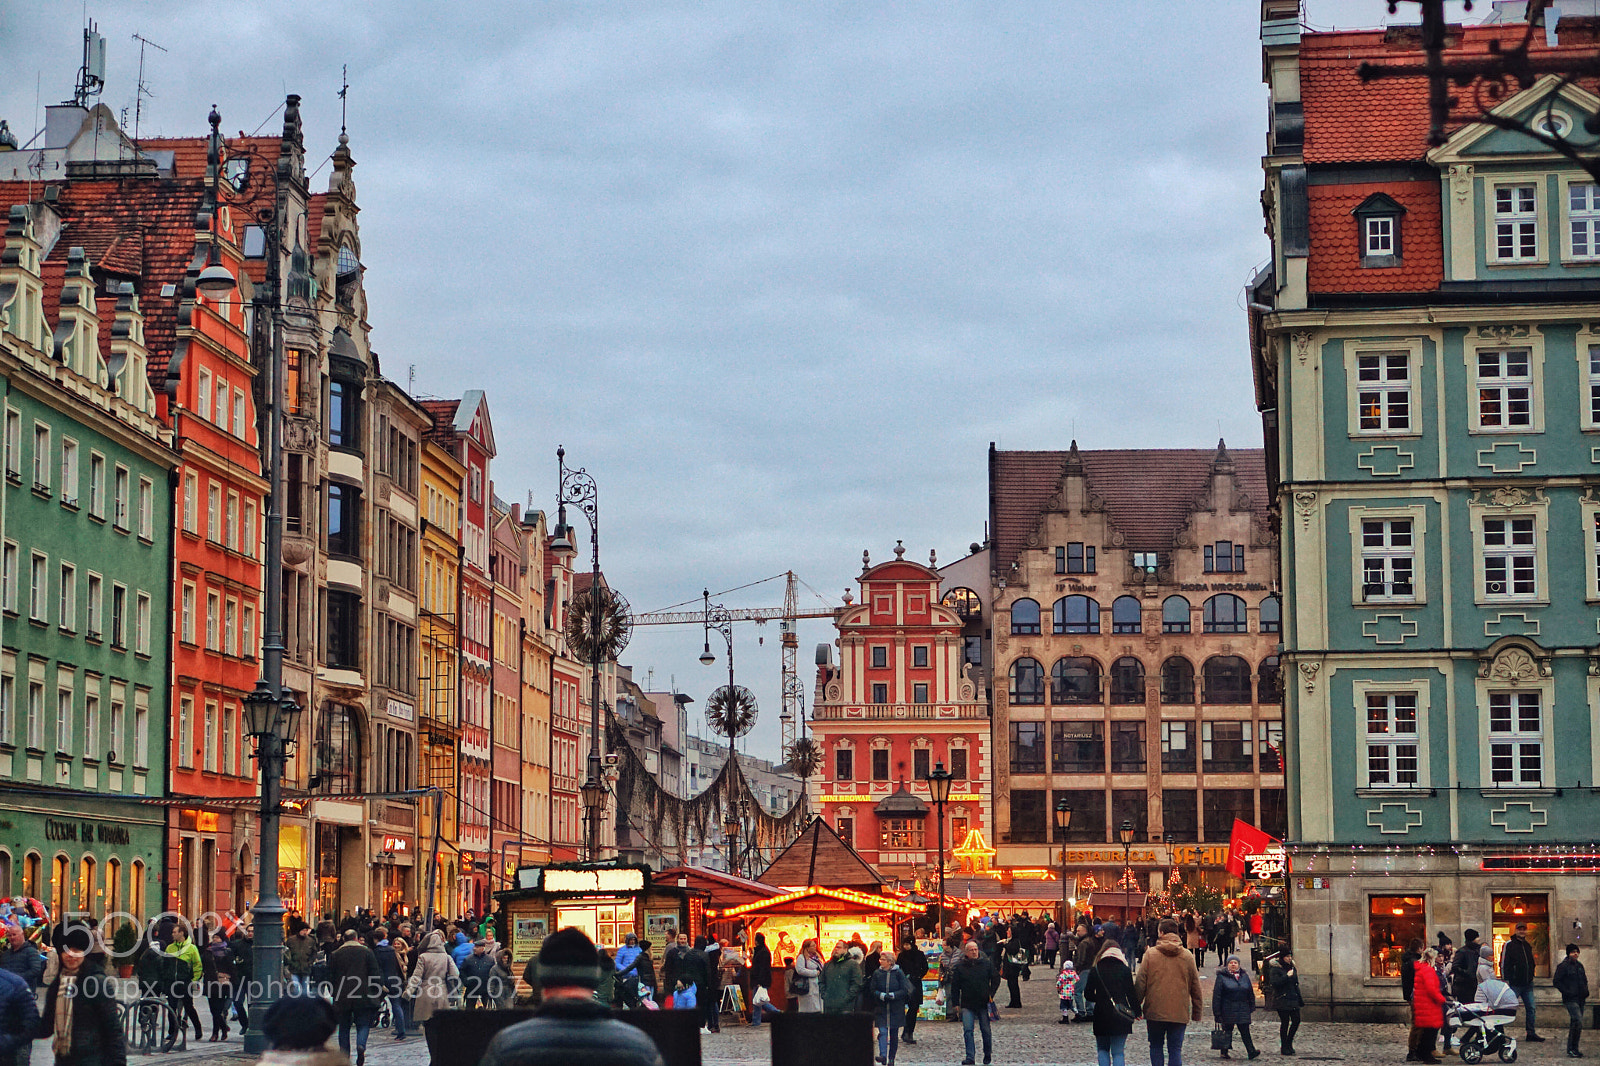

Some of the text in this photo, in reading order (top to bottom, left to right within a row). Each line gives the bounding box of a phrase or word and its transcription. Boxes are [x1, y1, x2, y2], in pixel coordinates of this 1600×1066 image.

[1181, 583, 1209, 591] MODA
[819, 794, 839, 802] MINI
[839, 794, 872, 802] BROWAR
[1058, 851, 1158, 862] RESTAURACJA
